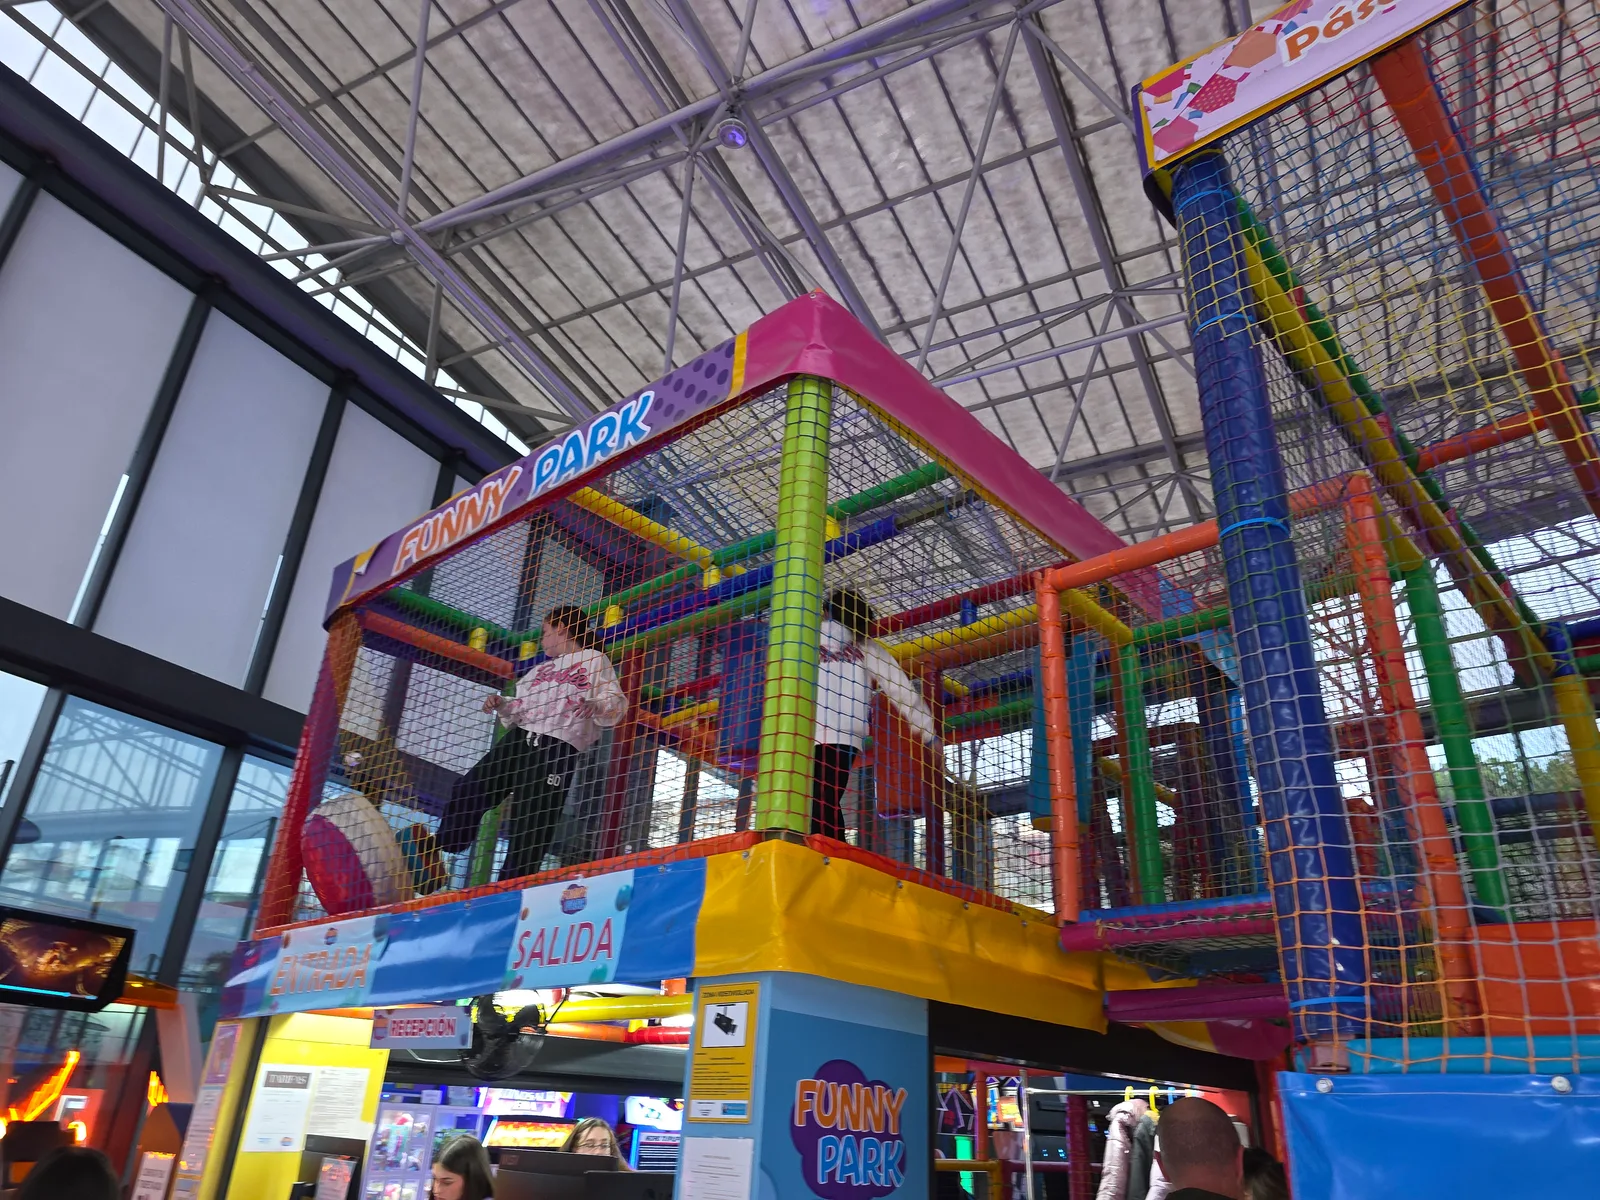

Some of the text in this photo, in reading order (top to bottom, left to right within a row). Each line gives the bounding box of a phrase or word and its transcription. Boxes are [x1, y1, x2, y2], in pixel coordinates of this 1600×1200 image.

[1283, 0, 1397, 63] Pás
[392, 391, 655, 576] FUNNY PARK
[269, 943, 373, 996] ENTRADA
[512, 917, 613, 970] SALIDA
[390, 1013, 457, 1037] RECEPCIÓN
[795, 1079, 907, 1134] FUNNY
[817, 1135, 905, 1187] PARK
